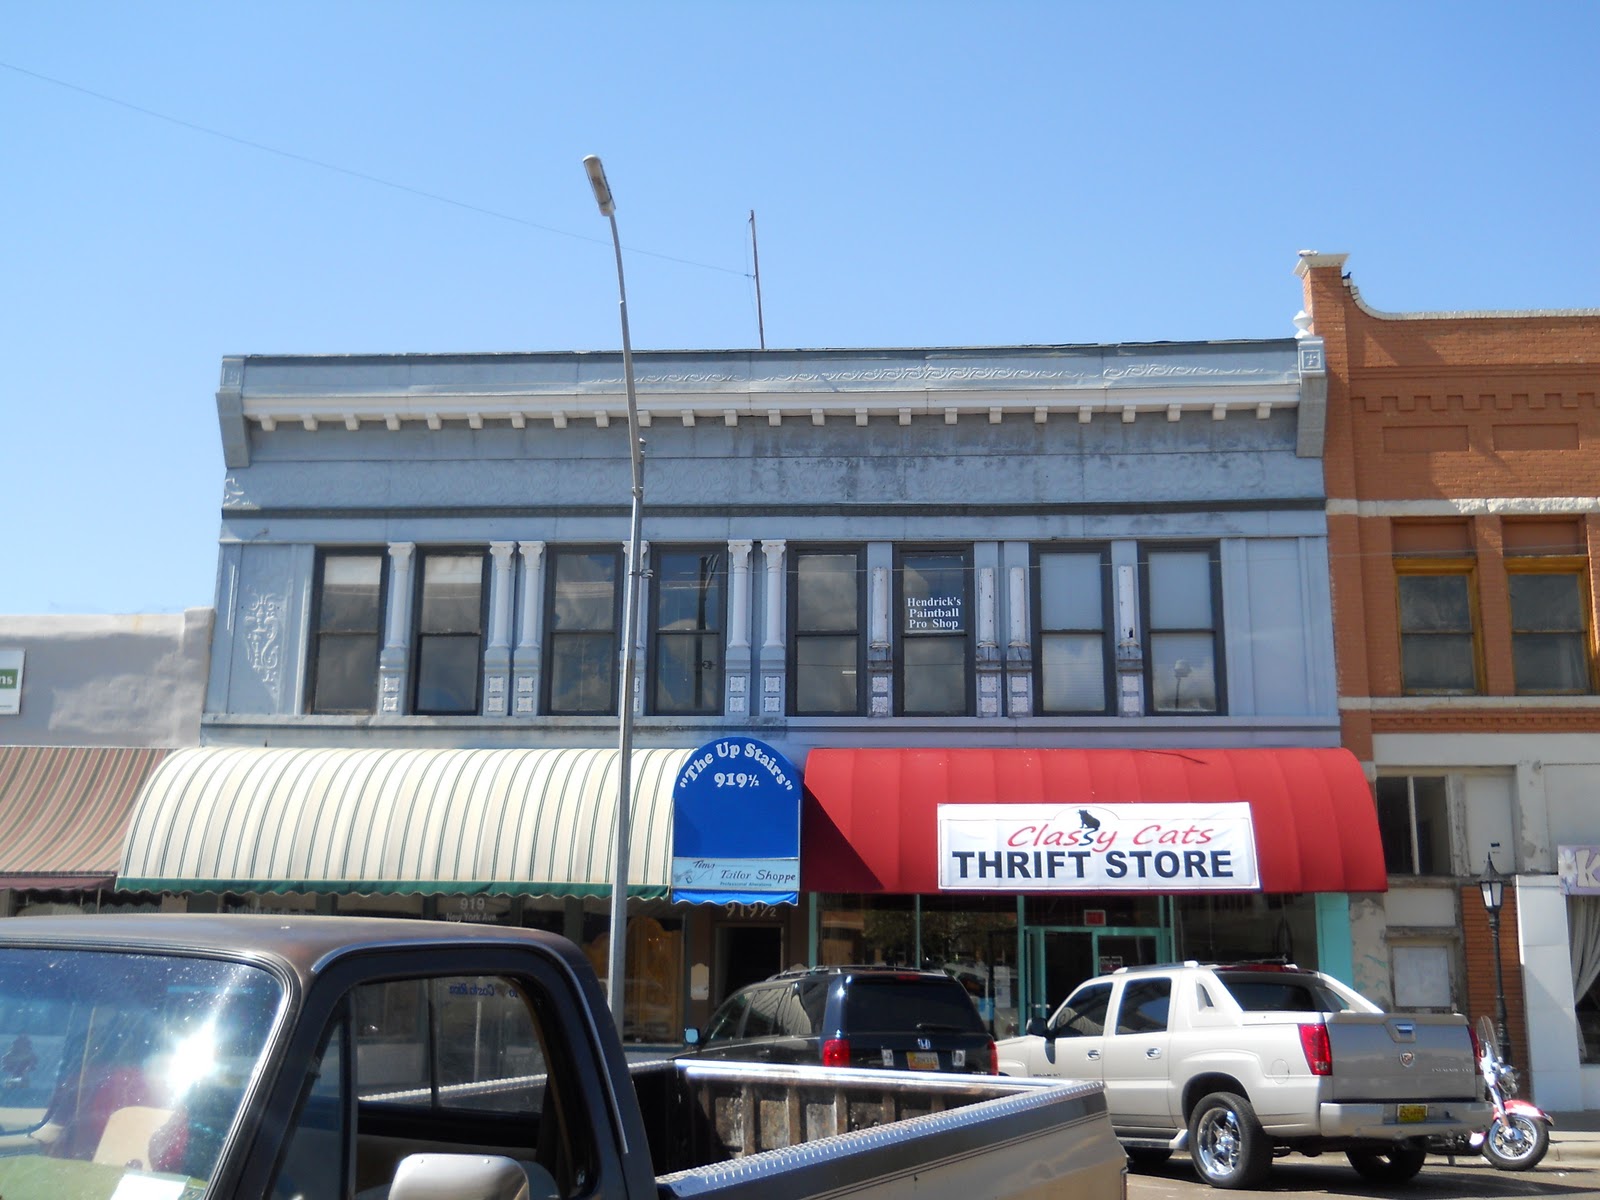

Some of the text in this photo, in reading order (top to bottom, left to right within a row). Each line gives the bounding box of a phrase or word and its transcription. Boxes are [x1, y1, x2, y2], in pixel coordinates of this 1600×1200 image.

[907, 597, 961, 607] Hendrick's
[909, 607, 959, 618] Paintball
[909, 618, 959, 630] Pro Shop
[680, 741, 793, 790] "The Up Stairs"
[1007, 824, 1215, 852] Classy Cats
[952, 850, 1234, 879] THRIFT STORE
[721, 869, 796, 883] Tailor Shoppe
[460, 897, 486, 911] 919
[464, 913, 481, 921] York
